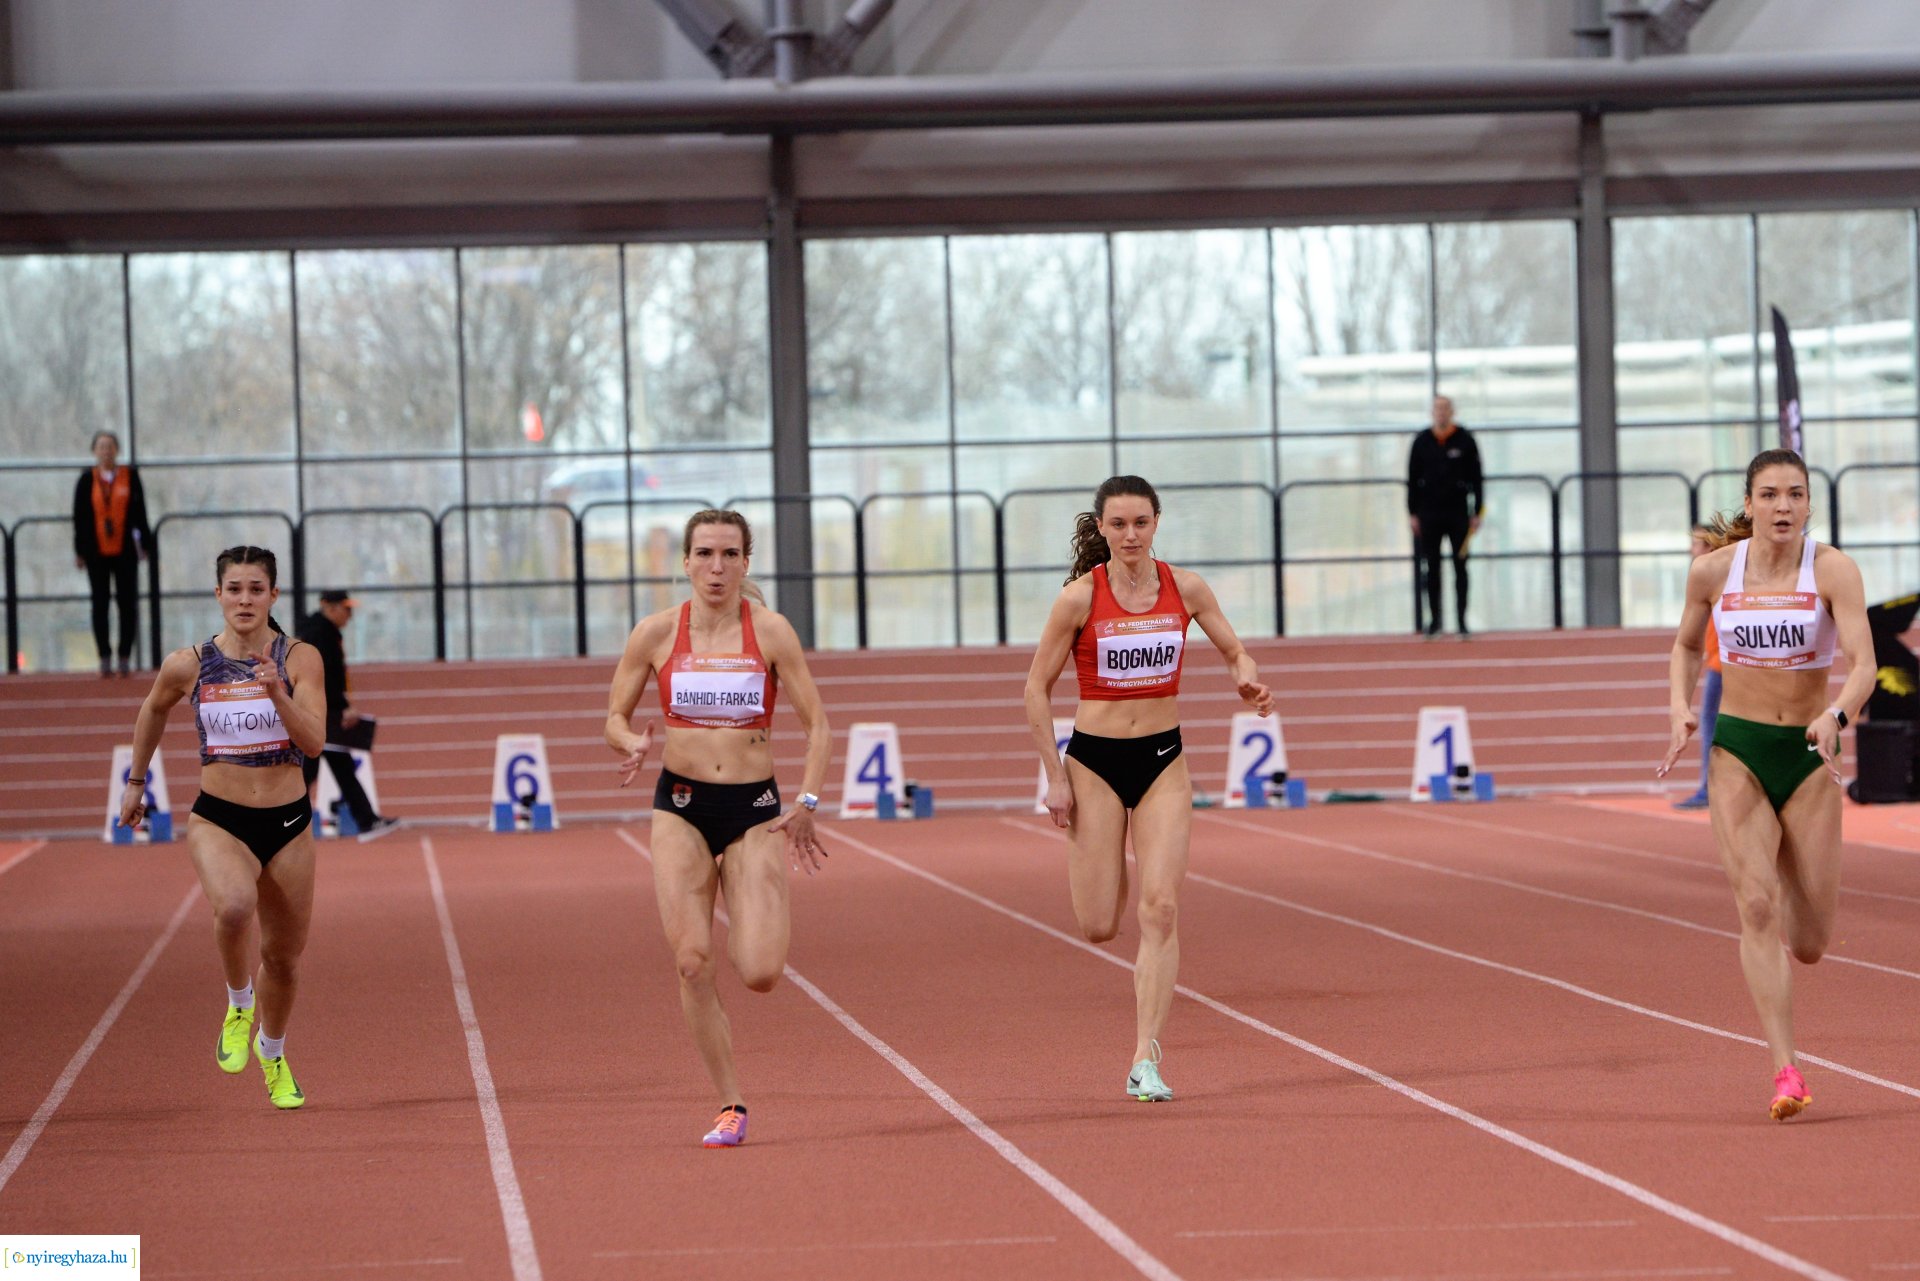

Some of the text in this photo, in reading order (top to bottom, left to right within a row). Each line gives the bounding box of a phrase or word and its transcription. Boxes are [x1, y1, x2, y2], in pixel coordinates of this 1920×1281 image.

[1734, 620, 1805, 648] SULYÁN
[1107, 642, 1175, 670] BOGNÁR
[1107, 678, 1157, 688] NYÍREGYHÁZA
[676, 689, 760, 706] BÁNHIDI-FARKAS
[208, 709, 284, 735] KATONA
[213, 743, 281, 755] NYÍREGYHÁZA 2023
[1242, 731, 1275, 782] 2
[1431, 724, 1455, 775] 1
[506, 753, 539, 803] 6
[856, 741, 893, 793] 4
[752, 798, 777, 807] adidas
